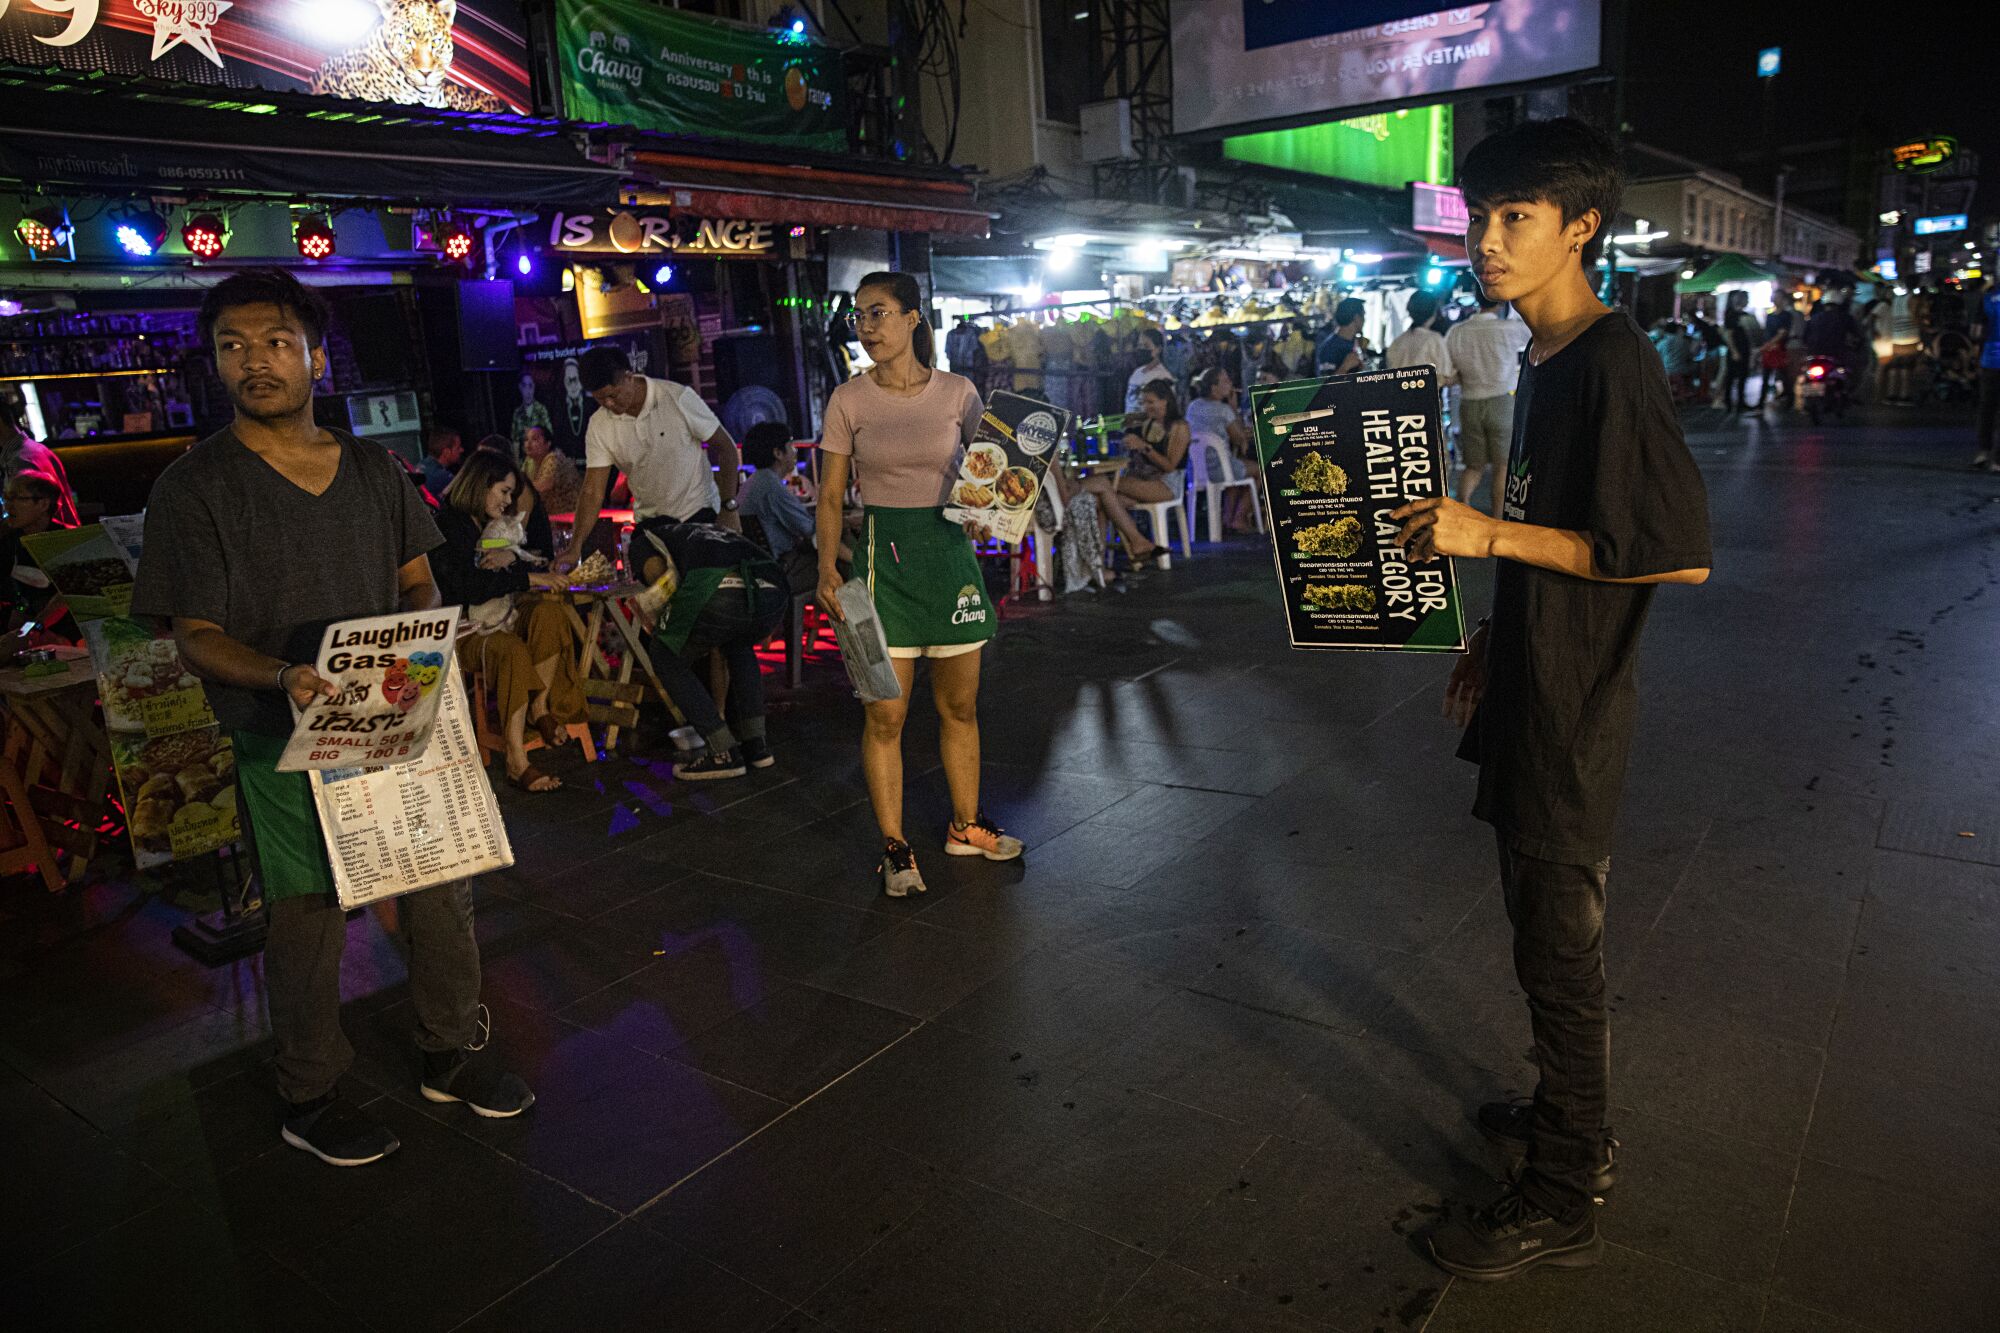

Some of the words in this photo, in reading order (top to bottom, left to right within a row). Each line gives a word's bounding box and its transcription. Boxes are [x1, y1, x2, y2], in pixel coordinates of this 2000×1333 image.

[188, 1, 217, 23] 999
[577, 46, 643, 88] Chang
[661, 46, 732, 78] Anniversary
[763, 70, 772, 84] is
[550, 211, 595, 247] IS
[1361, 410, 1398, 500] HEALTH
[1414, 570, 1447, 614] FOR
[951, 608, 986, 625] Chang
[330, 619, 450, 649] Laughing
[327, 652, 396, 674] Gas
[309, 750, 340, 761] BIG
[364, 748, 393, 760] 100
[316, 736, 375, 746] SMALL
[379, 735, 399, 746] 50
